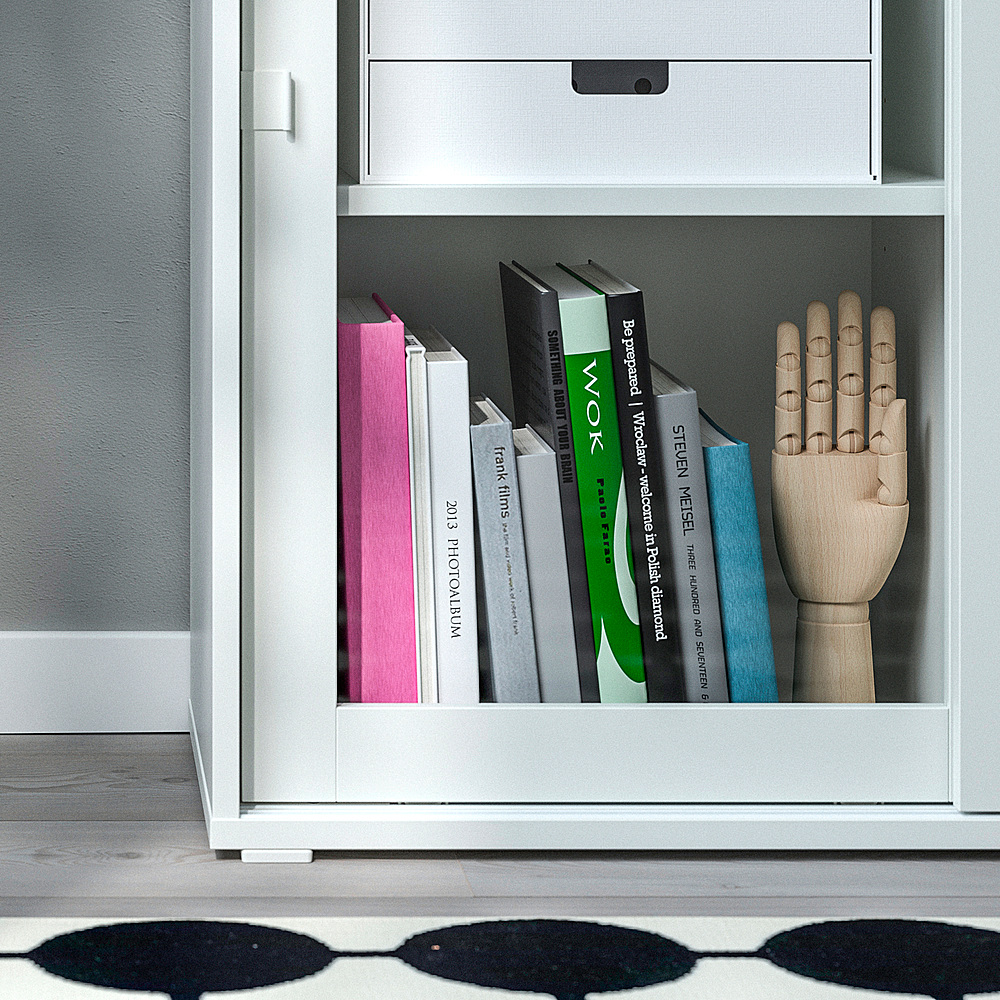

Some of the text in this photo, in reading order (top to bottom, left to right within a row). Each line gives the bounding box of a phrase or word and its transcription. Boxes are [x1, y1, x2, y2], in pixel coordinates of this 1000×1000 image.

[622, 319, 635, 336] Be
[621, 338, 642, 397] prepared
[548, 330, 574, 484] SOMETHING ABOUT YOUR BRAIN
[582, 357, 604, 455] WOK
[632, 410, 648, 467] Wroclaw
[494, 446, 511, 519] frank films
[639, 474, 654, 531] welcome
[672, 424, 695, 536] STEVEN MEISEL
[596, 478, 611, 564] Paolo Farao
[645, 533, 658, 546] in
[446, 500, 461, 639] 2013 PHOTOALBUM
[646, 546, 662, 584] Polish
[686, 544, 696, 570] THREE
[650, 585, 668, 642] diamond
[689, 575, 701, 615] HUNDRED
[694, 618, 703, 637] AND
[695, 641, 709, 689] SEVENTEEN
